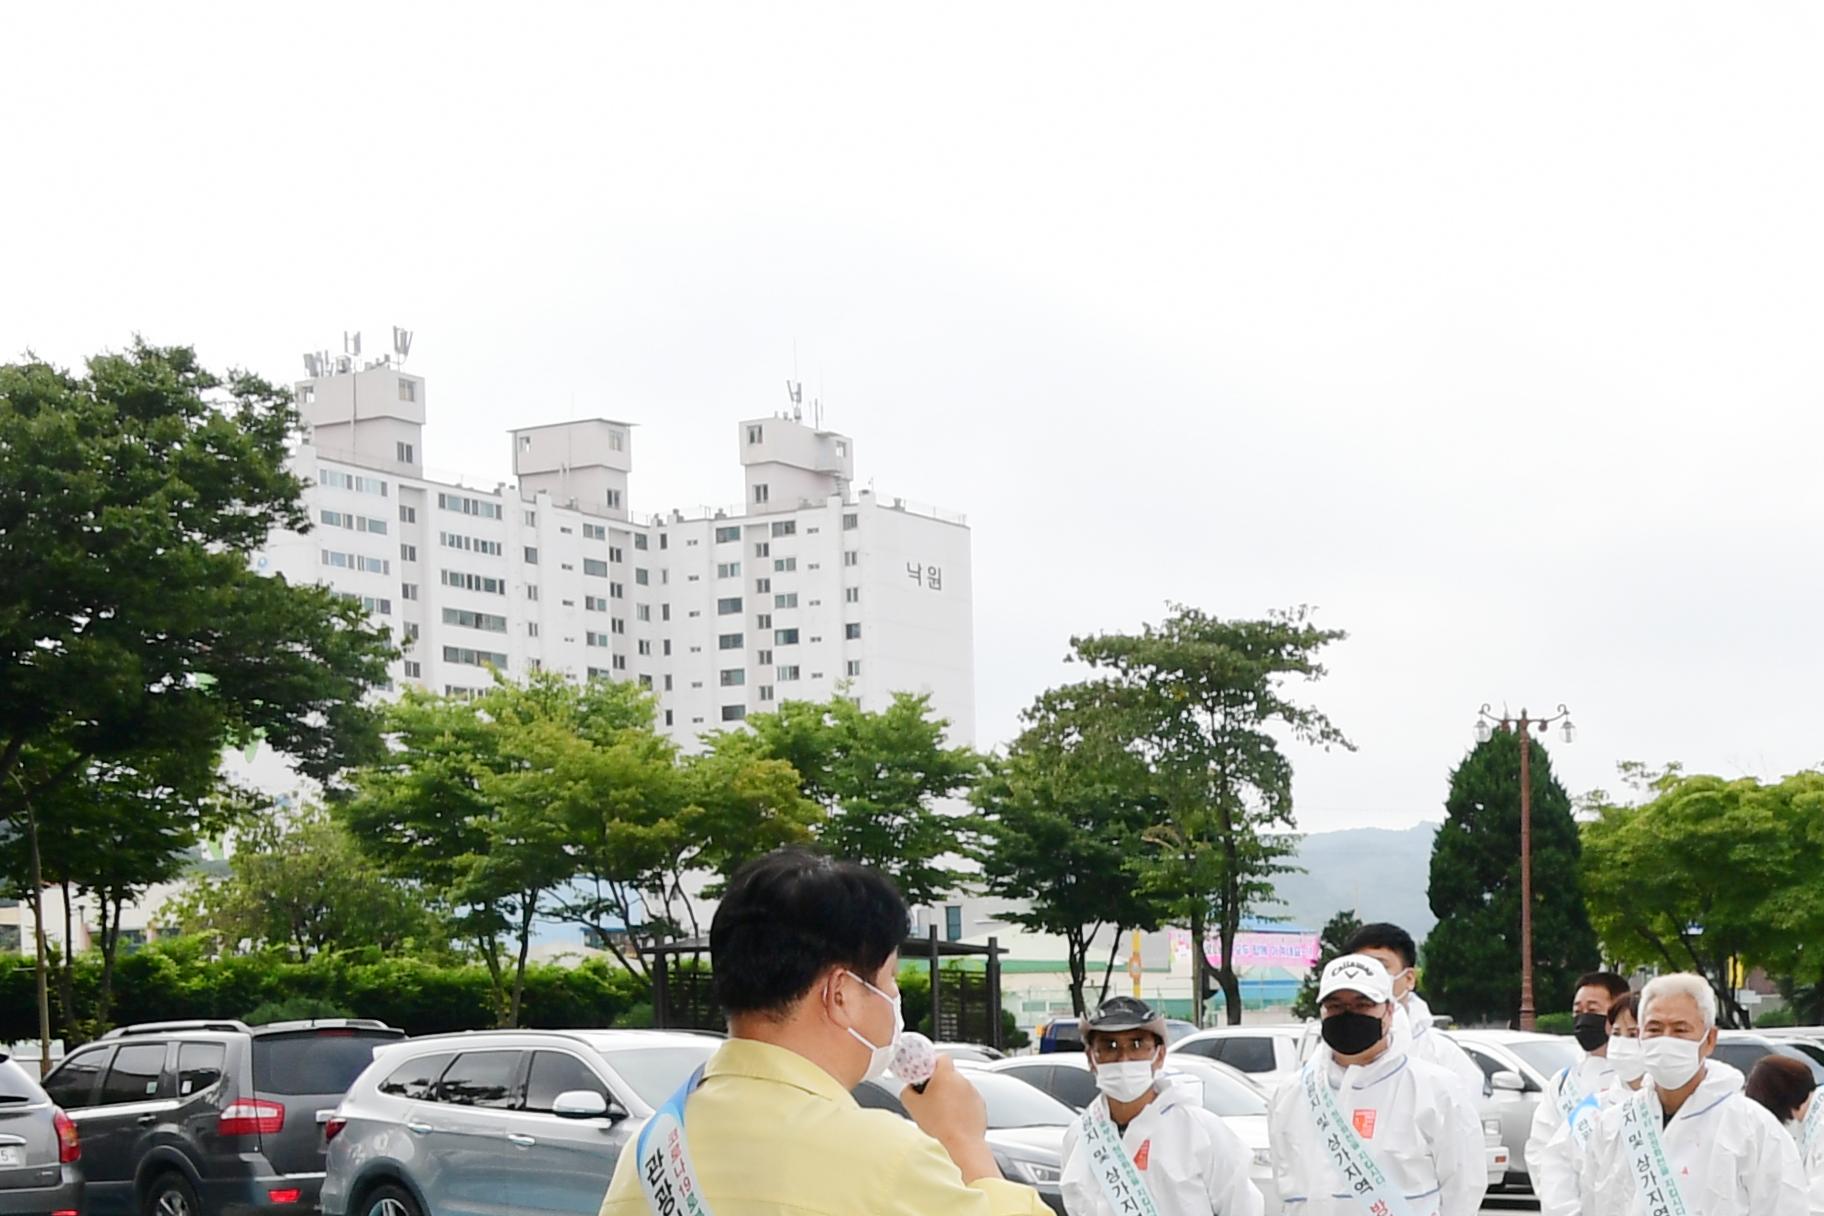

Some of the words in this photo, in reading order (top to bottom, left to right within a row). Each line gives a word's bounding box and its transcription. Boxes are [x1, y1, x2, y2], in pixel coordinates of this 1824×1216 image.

[906, 561, 942, 592] 낙원
[1628, 1132, 1645, 1150] 및
[1328, 1132, 1374, 1198] 상가지역
